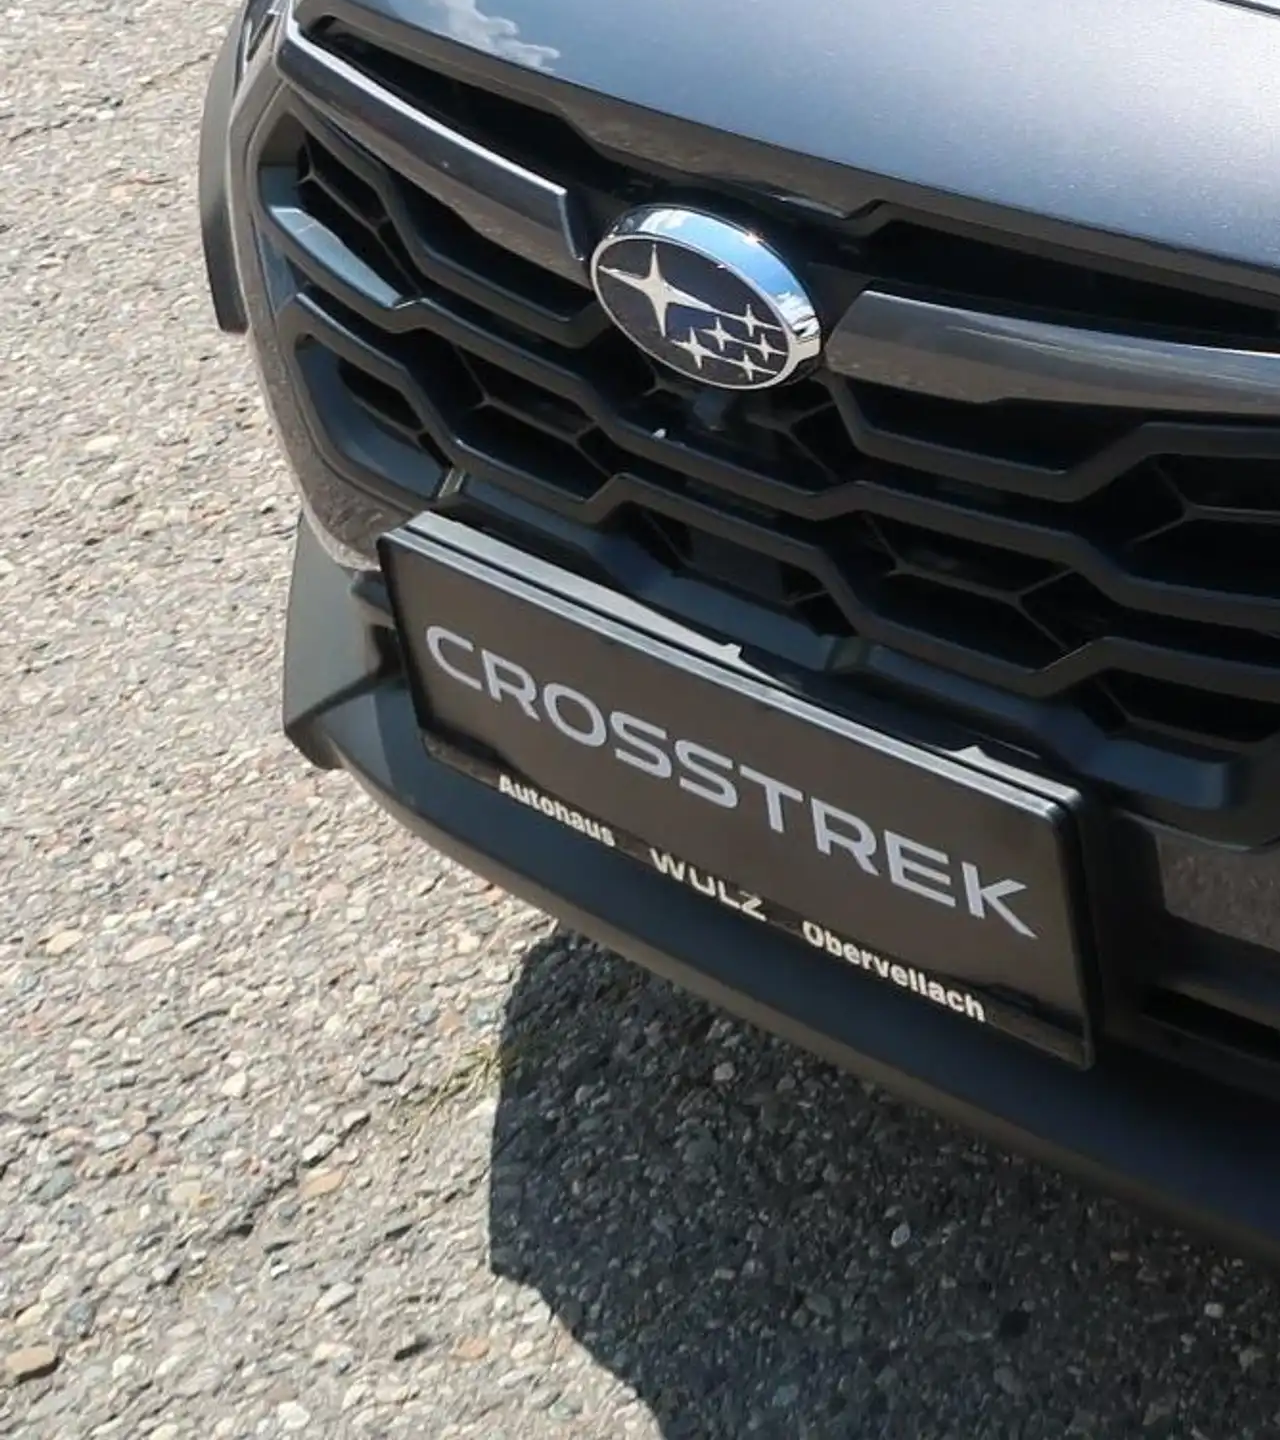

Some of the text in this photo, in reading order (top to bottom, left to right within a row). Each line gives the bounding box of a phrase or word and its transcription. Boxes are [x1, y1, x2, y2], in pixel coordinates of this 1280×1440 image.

[425, 625, 1038, 939] CROSSTREK
[499, 774, 985, 1022] Autohaus WULZ Obervellach
